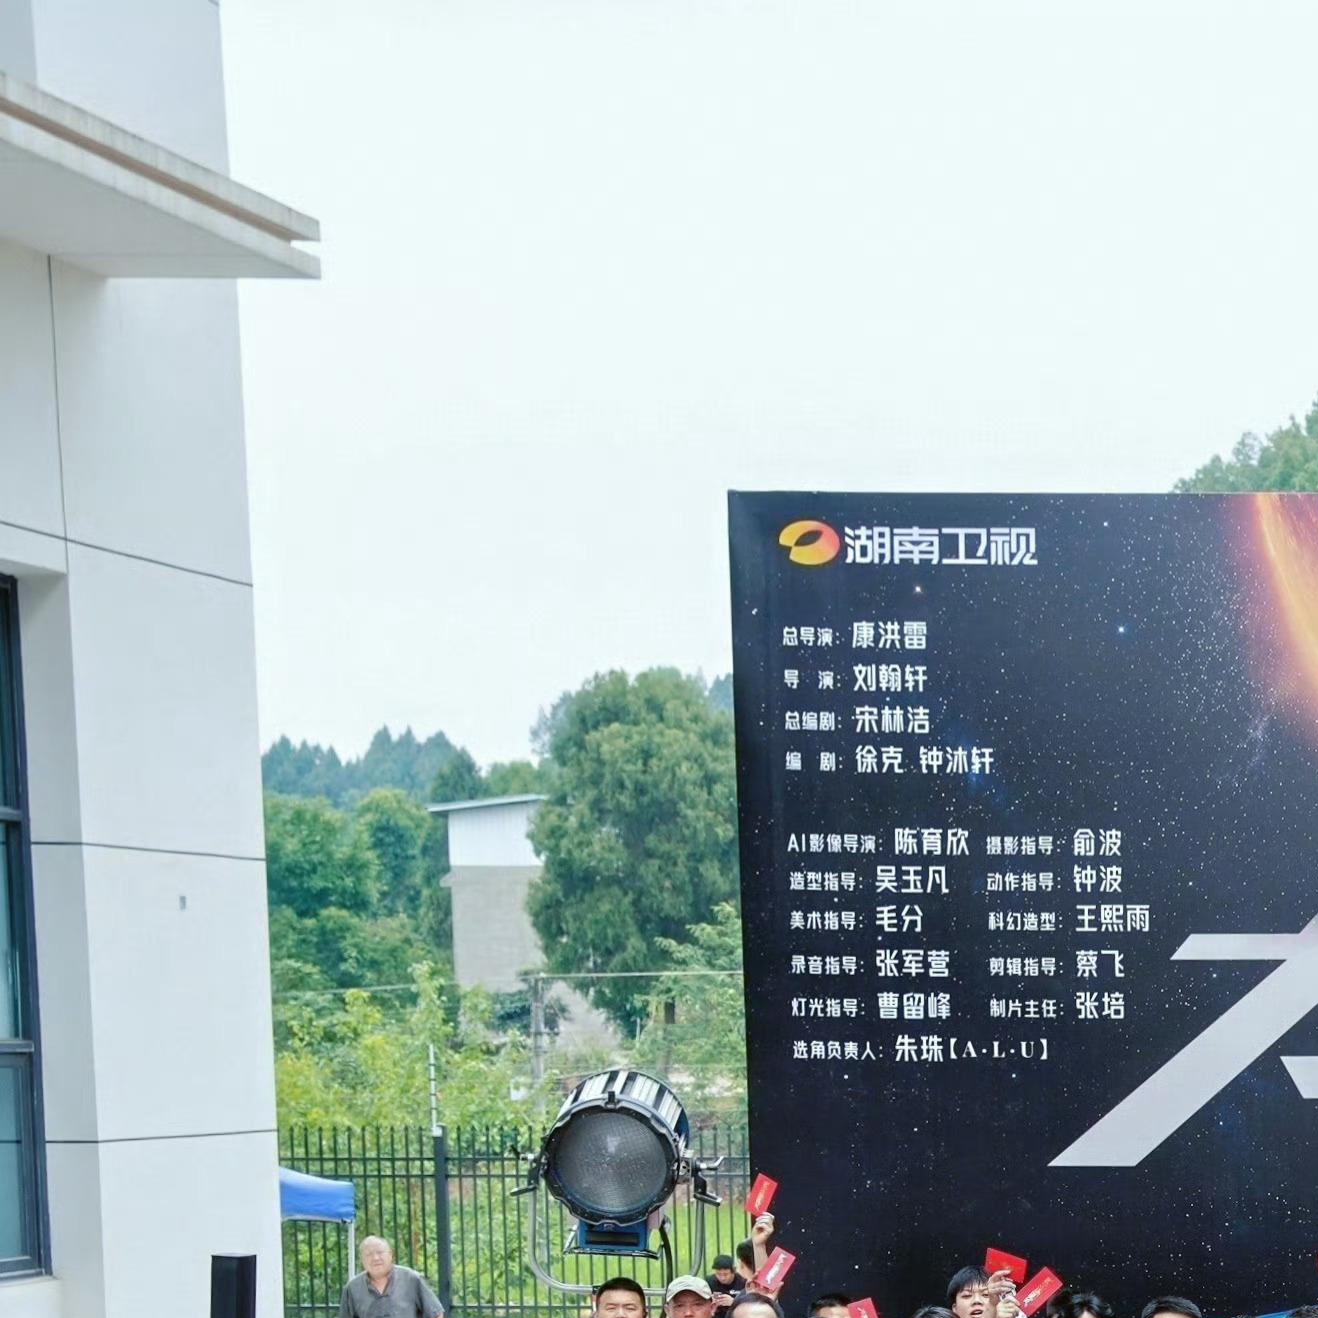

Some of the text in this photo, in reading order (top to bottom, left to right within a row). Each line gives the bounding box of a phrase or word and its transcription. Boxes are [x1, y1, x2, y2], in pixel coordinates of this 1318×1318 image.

[844, 527, 1038, 566] 湖南卫视
[852, 621, 928, 650] 康洪雷
[853, 664, 928, 693] 刘翰轩
[855, 706, 930, 735] 宋林洁
[855, 746, 904, 775] 徐克
[919, 746, 995, 775] 钟沐轩
[894, 828, 969, 857] 陈育欣
[1073, 828, 1122, 857] 俞波
[876, 866, 949, 894] 吴玉凡
[1073, 864, 1122, 893] 钟波
[876, 905, 923, 933] 毛分
[1075, 904, 1150, 933] 王熙雨
[876, 949, 950, 978] 张军营
[1076, 949, 1125, 979] 蔡飞
[877, 992, 951, 1020] 曹留峰
[1076, 991, 1125, 1020] 张培
